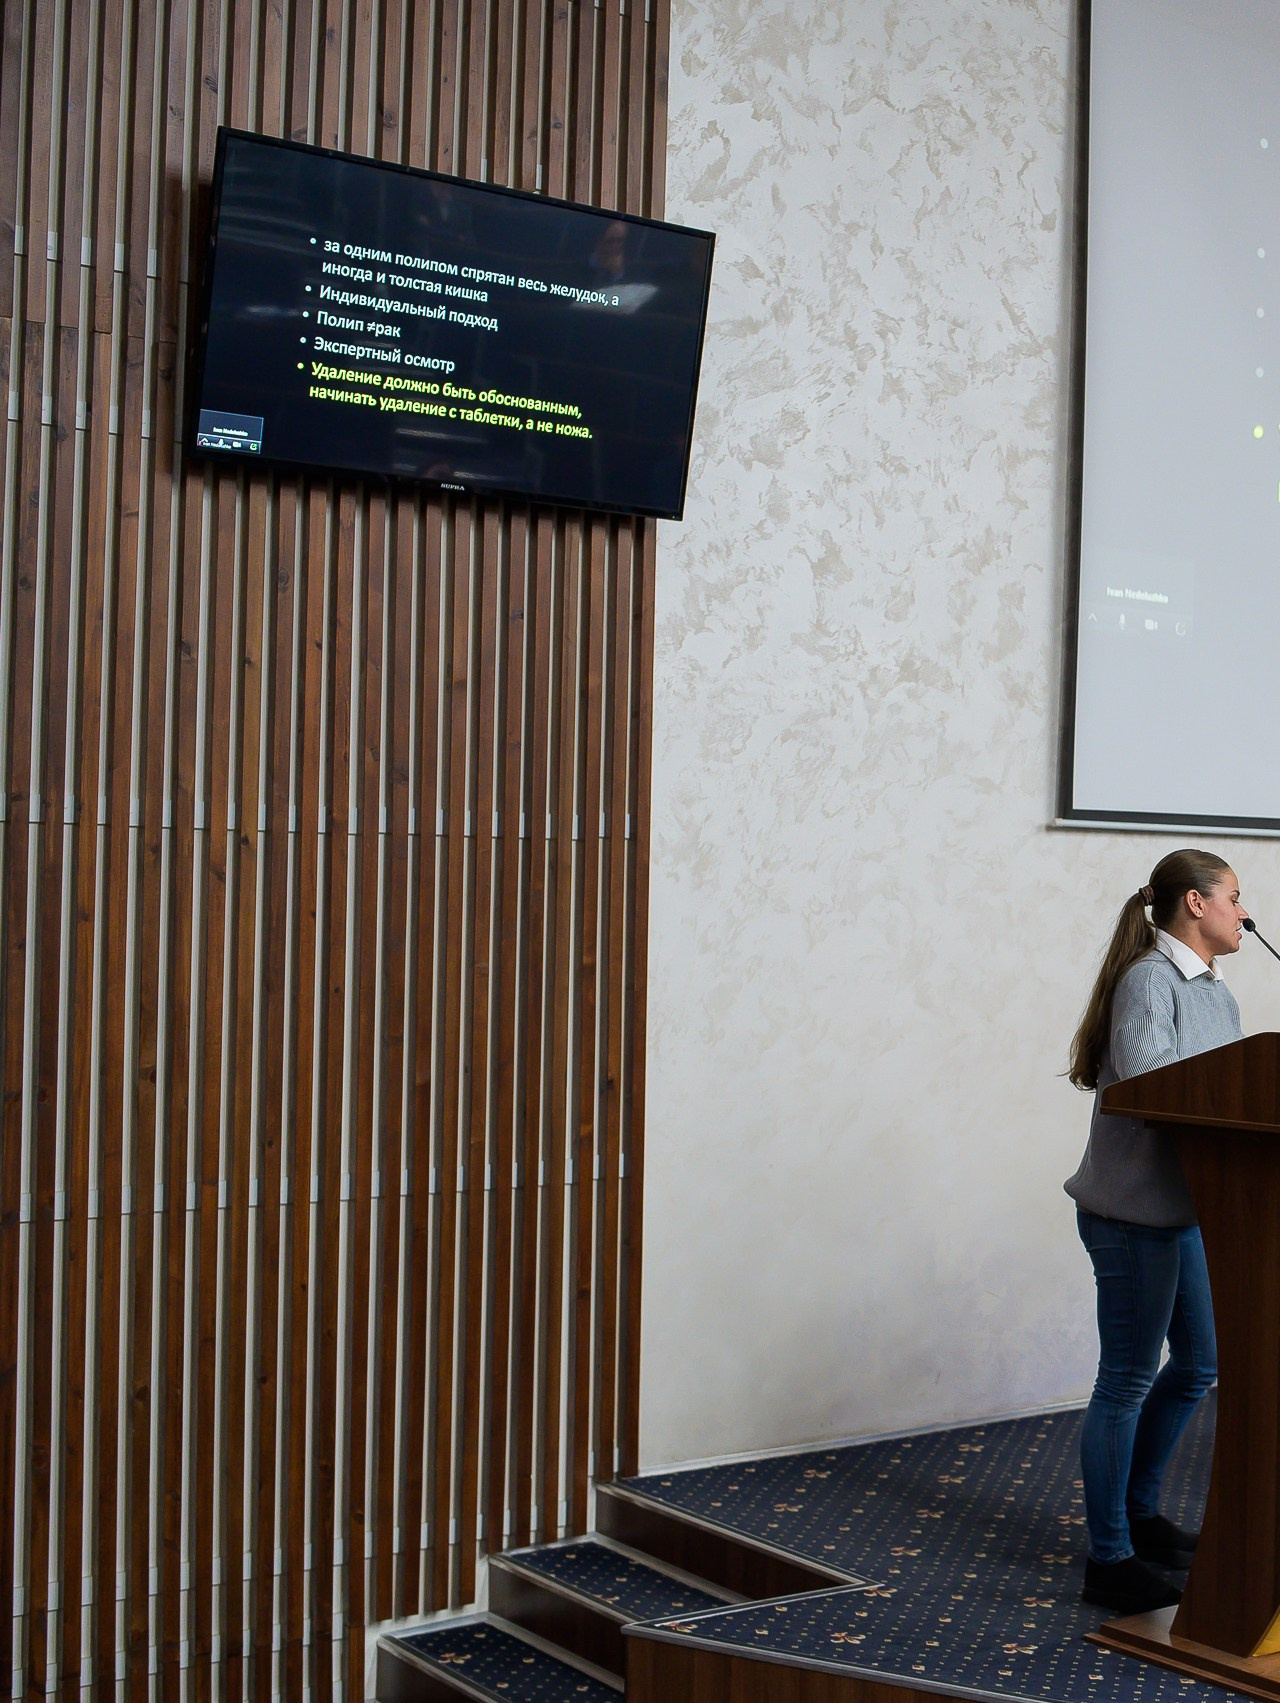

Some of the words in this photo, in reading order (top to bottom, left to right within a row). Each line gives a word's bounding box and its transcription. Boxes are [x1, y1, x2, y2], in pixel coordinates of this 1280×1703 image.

[322, 261, 373, 283] иногда
[376, 271, 386, 284] и
[388, 273, 442, 294] толстая
[445, 284, 489, 303] кишка
[324, 240, 340, 254] за
[344, 243, 392, 264] одним
[395, 253, 458, 276] полипом
[461, 266, 515, 287] спрятан
[518, 277, 547, 293] весь
[549, 283, 609, 306] желудок,
[611, 295, 620, 306] а
[317, 310, 364, 332] Полип
[319, 284, 446, 320] Индивидуальный
[449, 310, 498, 333] подход
[314, 336, 401, 364] Экспертный
[404, 353, 455, 375] осмотр
[309, 385, 377, 407] начинать
[379, 397, 447, 418] удаление
[449, 407, 457, 419] с
[459, 407, 523, 431] таблетки,
[526, 418, 534, 431] а
[537, 420, 553, 433] не
[556, 423, 593, 440] ножа.
[311, 362, 382, 387] Удаление
[383, 376, 440, 395] должно
[442, 382, 476, 401] быть
[479, 389, 582, 420] обоснованным,
